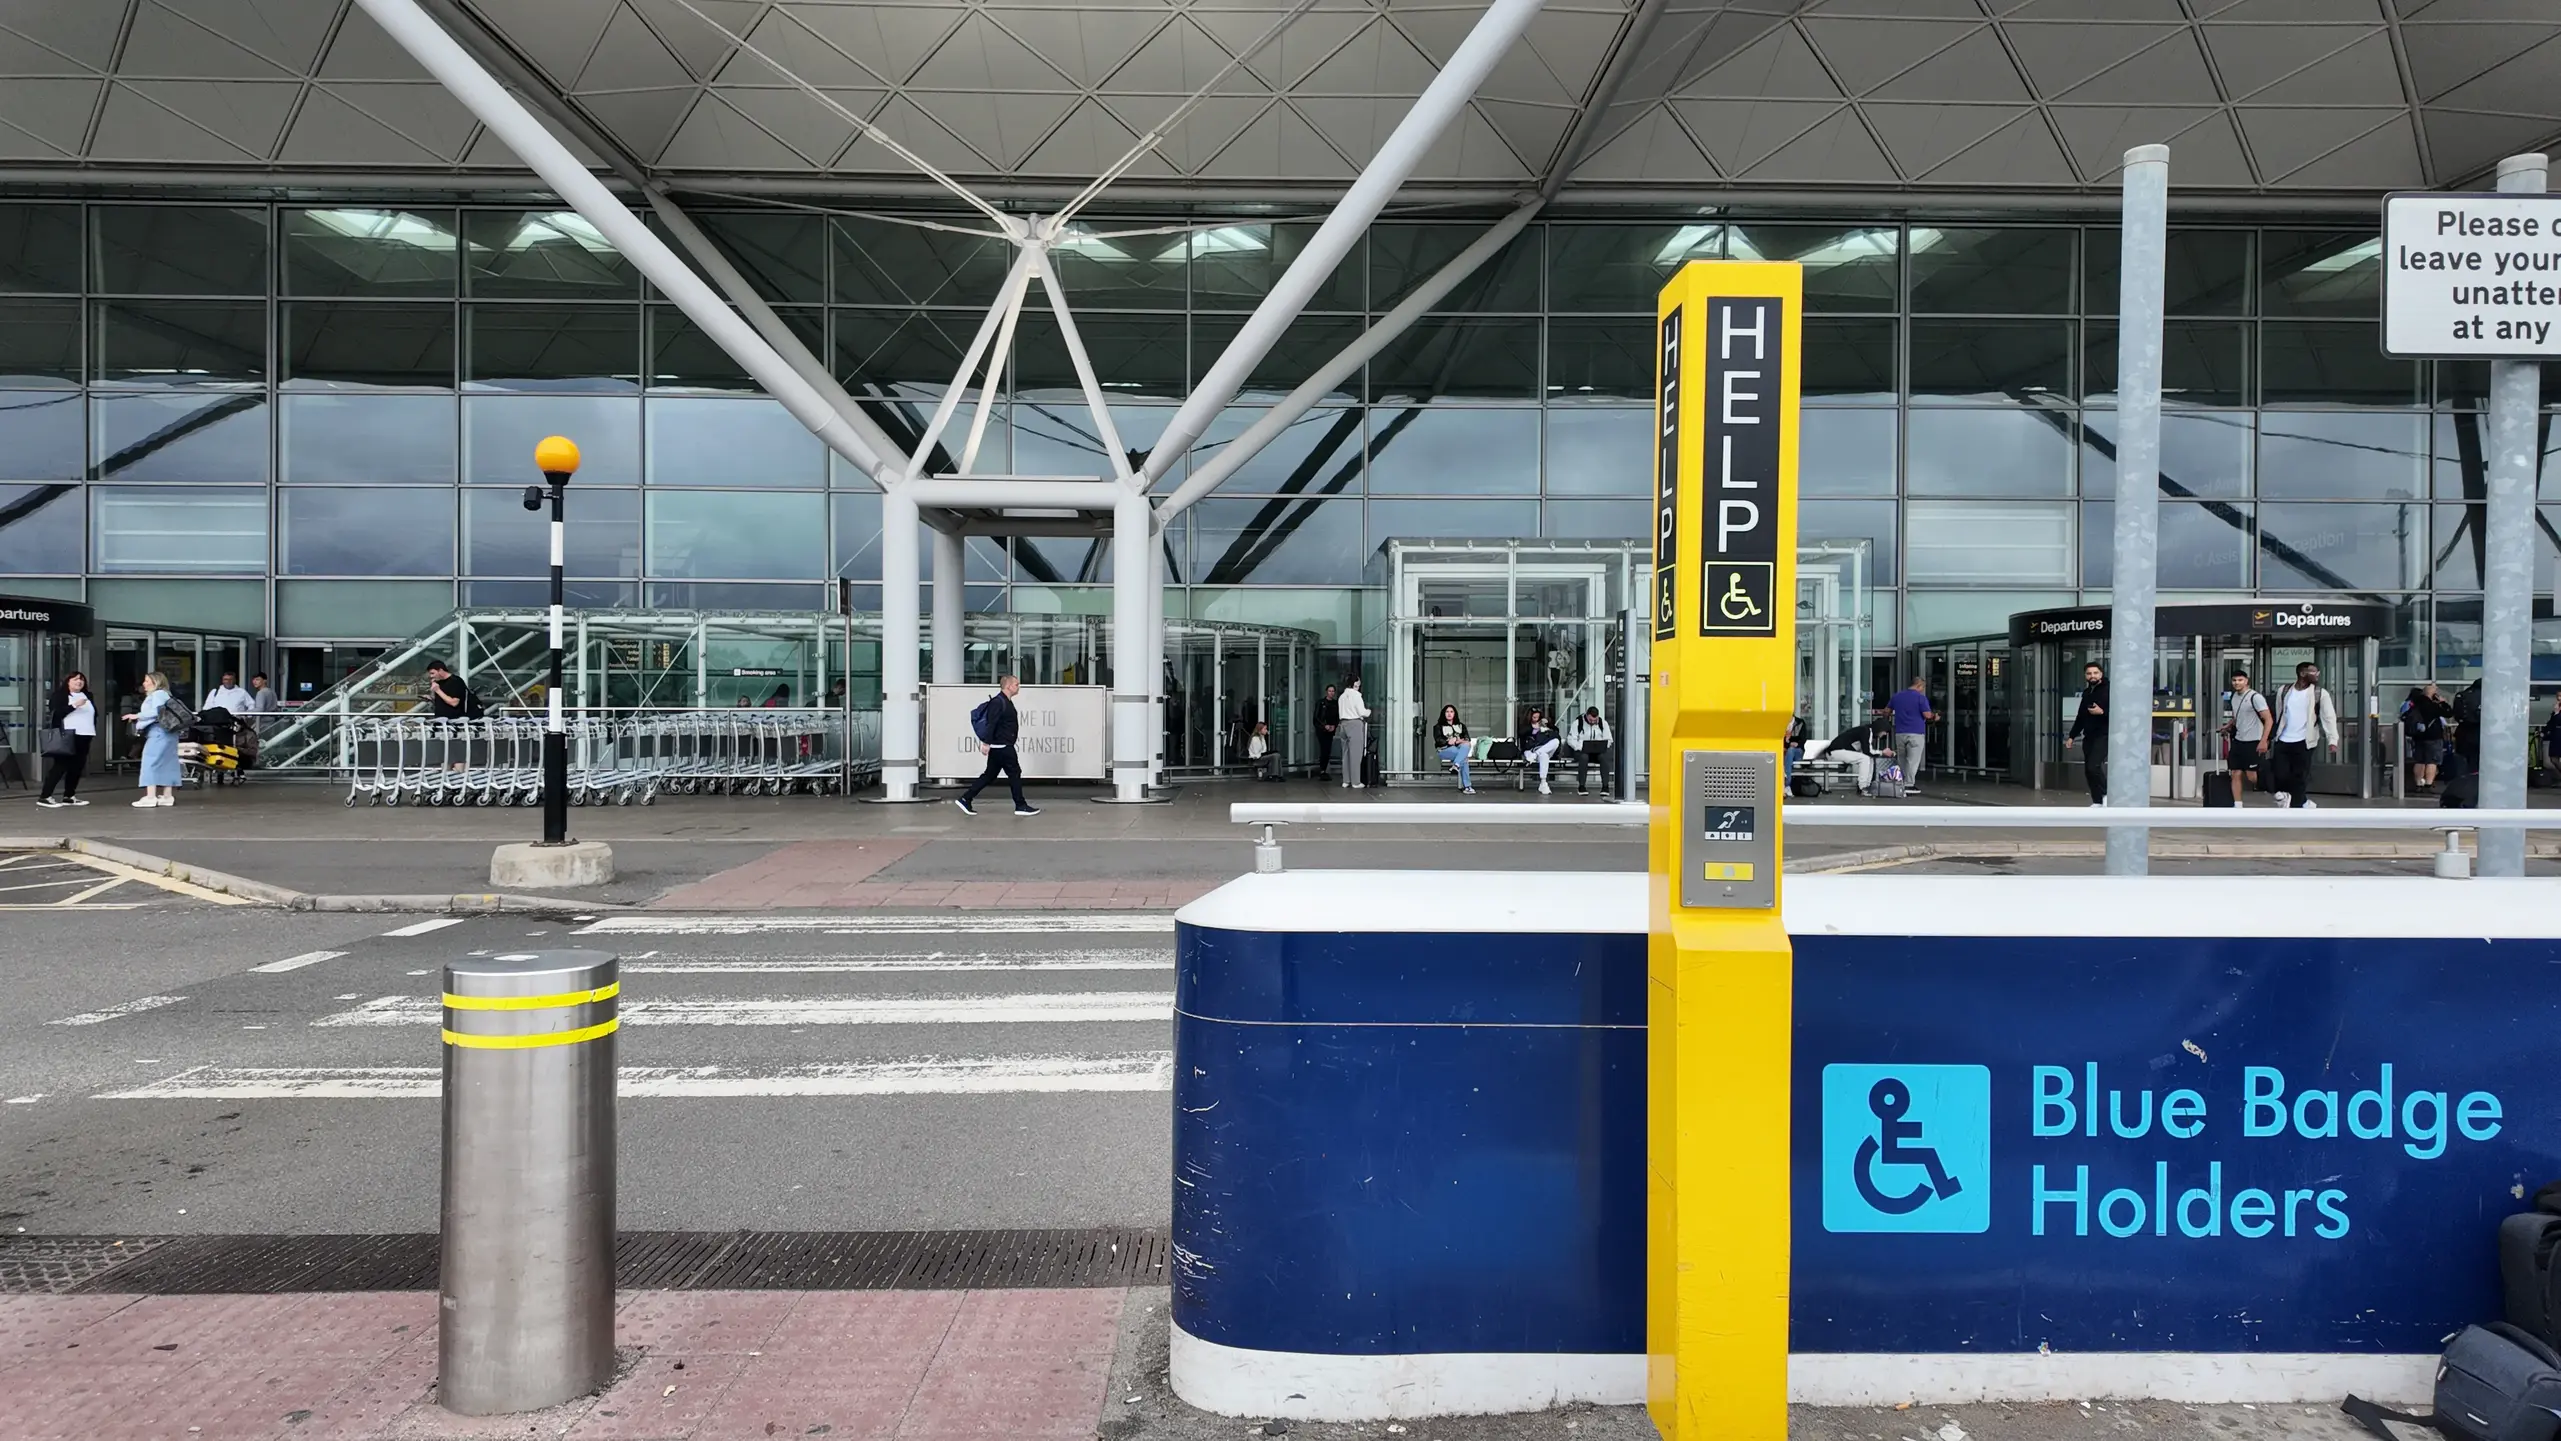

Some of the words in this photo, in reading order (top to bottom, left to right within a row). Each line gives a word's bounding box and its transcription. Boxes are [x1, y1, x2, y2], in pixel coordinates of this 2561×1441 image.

[2437, 210, 2539, 236] Please
[2400, 245, 2482, 270] leave
[2494, 251, 2561, 276] your
[2452, 280, 2561, 306] unatte
[2453, 315, 2484, 339] at
[2496, 320, 2551, 345] any
[1660, 315, 1679, 561] HELP
[1718, 305, 1765, 553] HELP
[2041, 619, 2104, 635] Departures
[2276, 612, 2352, 629] Departures
[1042, 710, 1056, 727] TO
[2032, 1062, 2206, 1139] Blue
[2243, 1063, 2502, 1159] Badge
[2031, 1161, 2350, 1239] Holders
